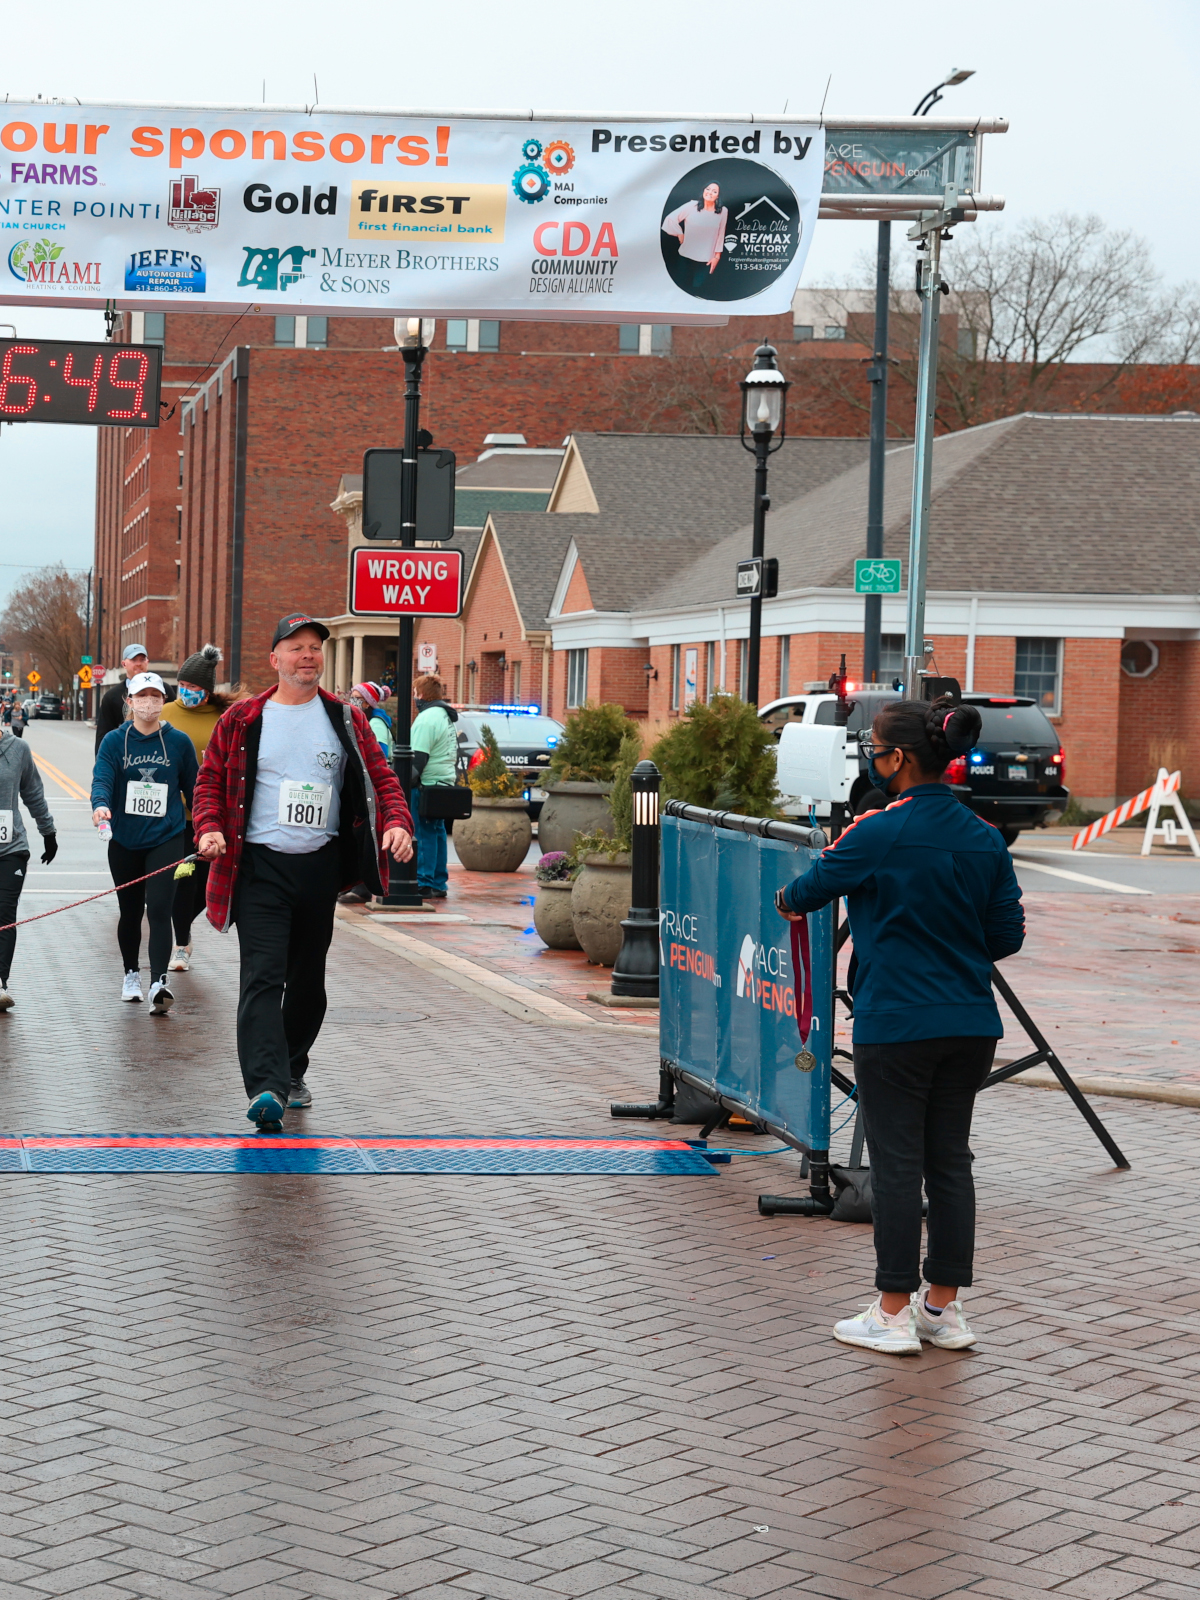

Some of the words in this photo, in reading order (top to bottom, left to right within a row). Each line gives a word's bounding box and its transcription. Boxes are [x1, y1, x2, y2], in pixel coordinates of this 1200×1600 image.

[0, 120, 111, 155] our
[130, 125, 452, 169] sponsors!
[591, 128, 761, 153] Presented
[773, 130, 813, 160] by
[825, 143, 863, 158] ACE
[10, 163, 98, 186] FARMS
[554, 183, 574, 192] MAJ
[243, 183, 338, 215] Gold
[554, 195, 608, 206] Companies
[22, 222, 66, 230] CHURCH
[358, 221, 387, 232] first
[392, 222, 452, 233] financial
[457, 223, 493, 235] bank
[533, 221, 619, 257] CDA
[740, 233, 791, 244] RE/MAX
[744, 245, 788, 253] VICTORY
[128, 249, 203, 276] JEFF'S
[320, 246, 392, 270] MEYER
[395, 248, 500, 272] BROTHERS
[531, 259, 618, 276] COMMUNITY
[27, 261, 102, 285] MIAMI
[136, 270, 194, 278] AUTOMOBILE
[320, 273, 337, 293] &
[340, 277, 390, 294] SONS
[529, 277, 565, 293] DESIGN
[567, 277, 614, 294] ALLIANCE
[367, 559, 448, 581] WRONG
[382, 584, 431, 605] WAY
[500, 755, 528, 764] POLICE
[970, 765, 994, 775] POLICE
[289, 791, 309, 800] QUEEN
[132, 798, 162, 815] 1802
[287, 803, 323, 825] 1801
[666, 910, 698, 942] RACE
